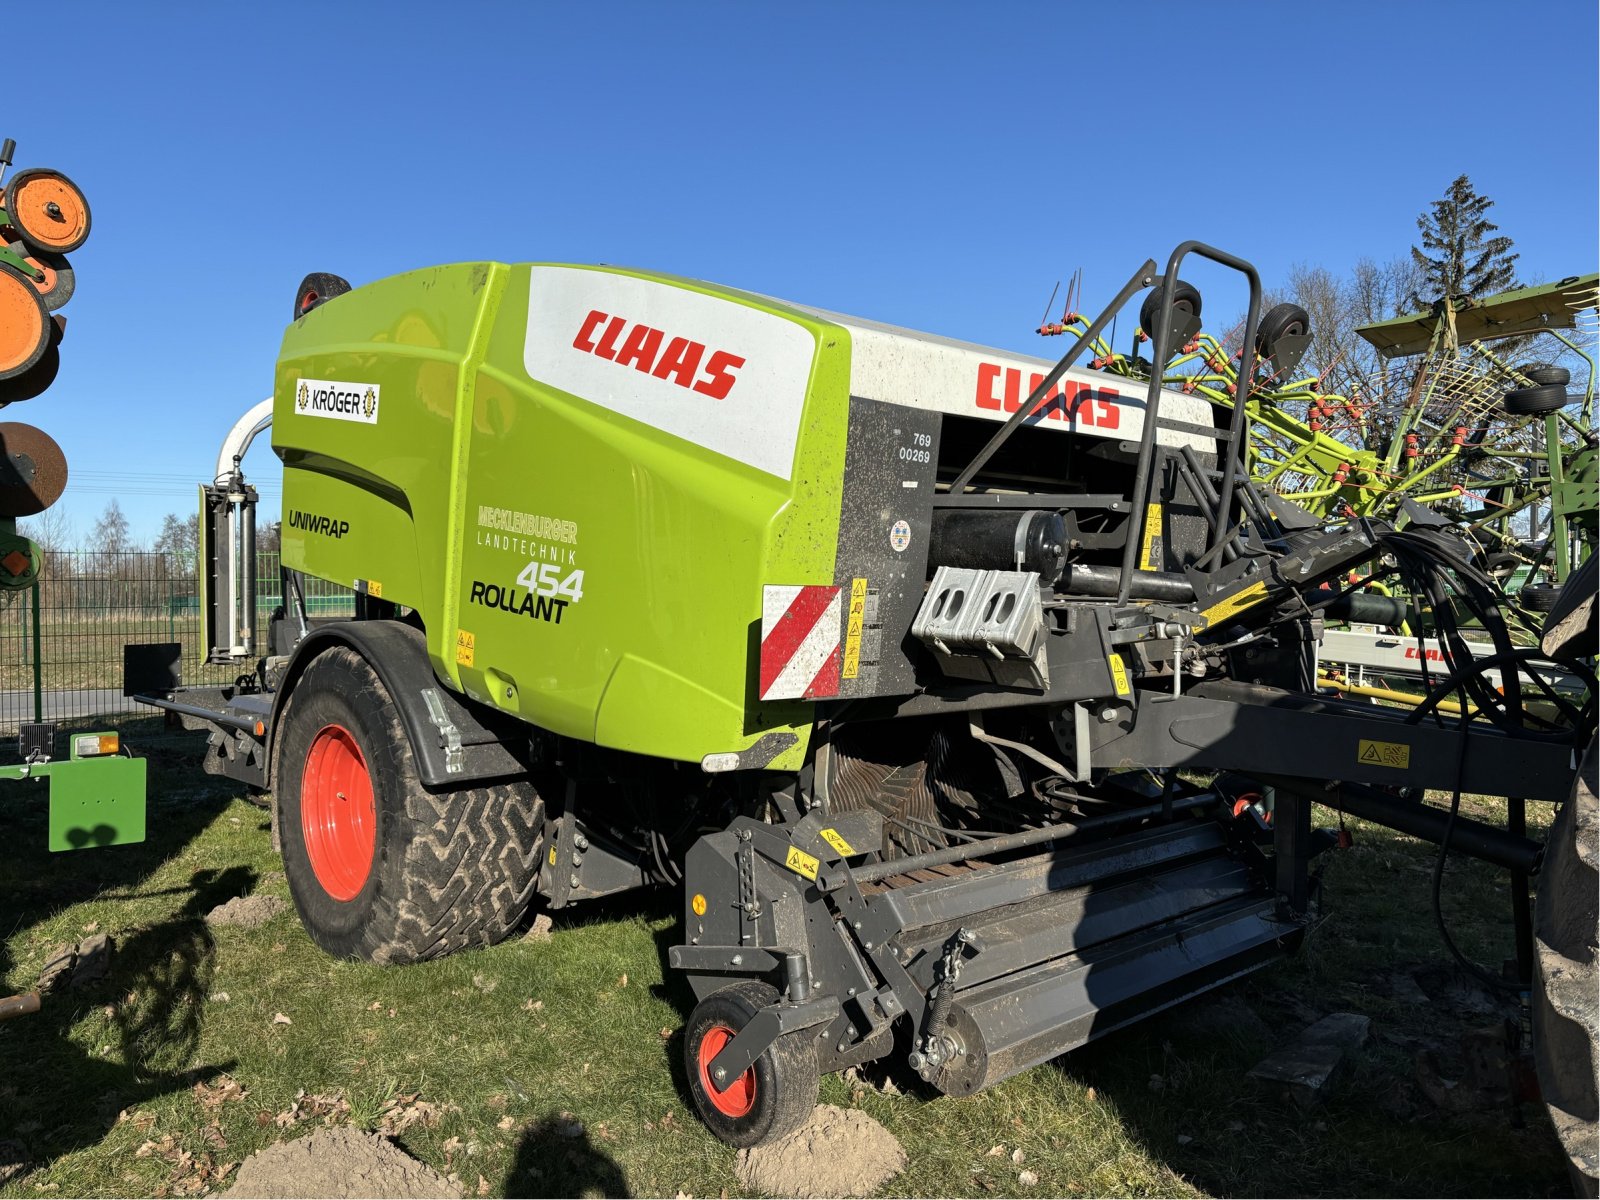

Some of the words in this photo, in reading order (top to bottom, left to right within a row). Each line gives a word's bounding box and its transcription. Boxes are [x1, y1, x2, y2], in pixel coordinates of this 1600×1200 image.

[572, 310, 746, 400] CLAAS
[312, 386, 361, 415] KRÖGER
[976, 362, 1120, 430] CLAAS
[899, 447, 930, 463] 00269
[913, 432, 931, 447] 769
[289, 509, 350, 539] UNIWRAP
[477, 505, 577, 544] MECKLENBURGER
[477, 531, 576, 565] LANDTECHNIK
[516, 561, 585, 603] 454
[470, 580, 569, 625] ROLLANT
